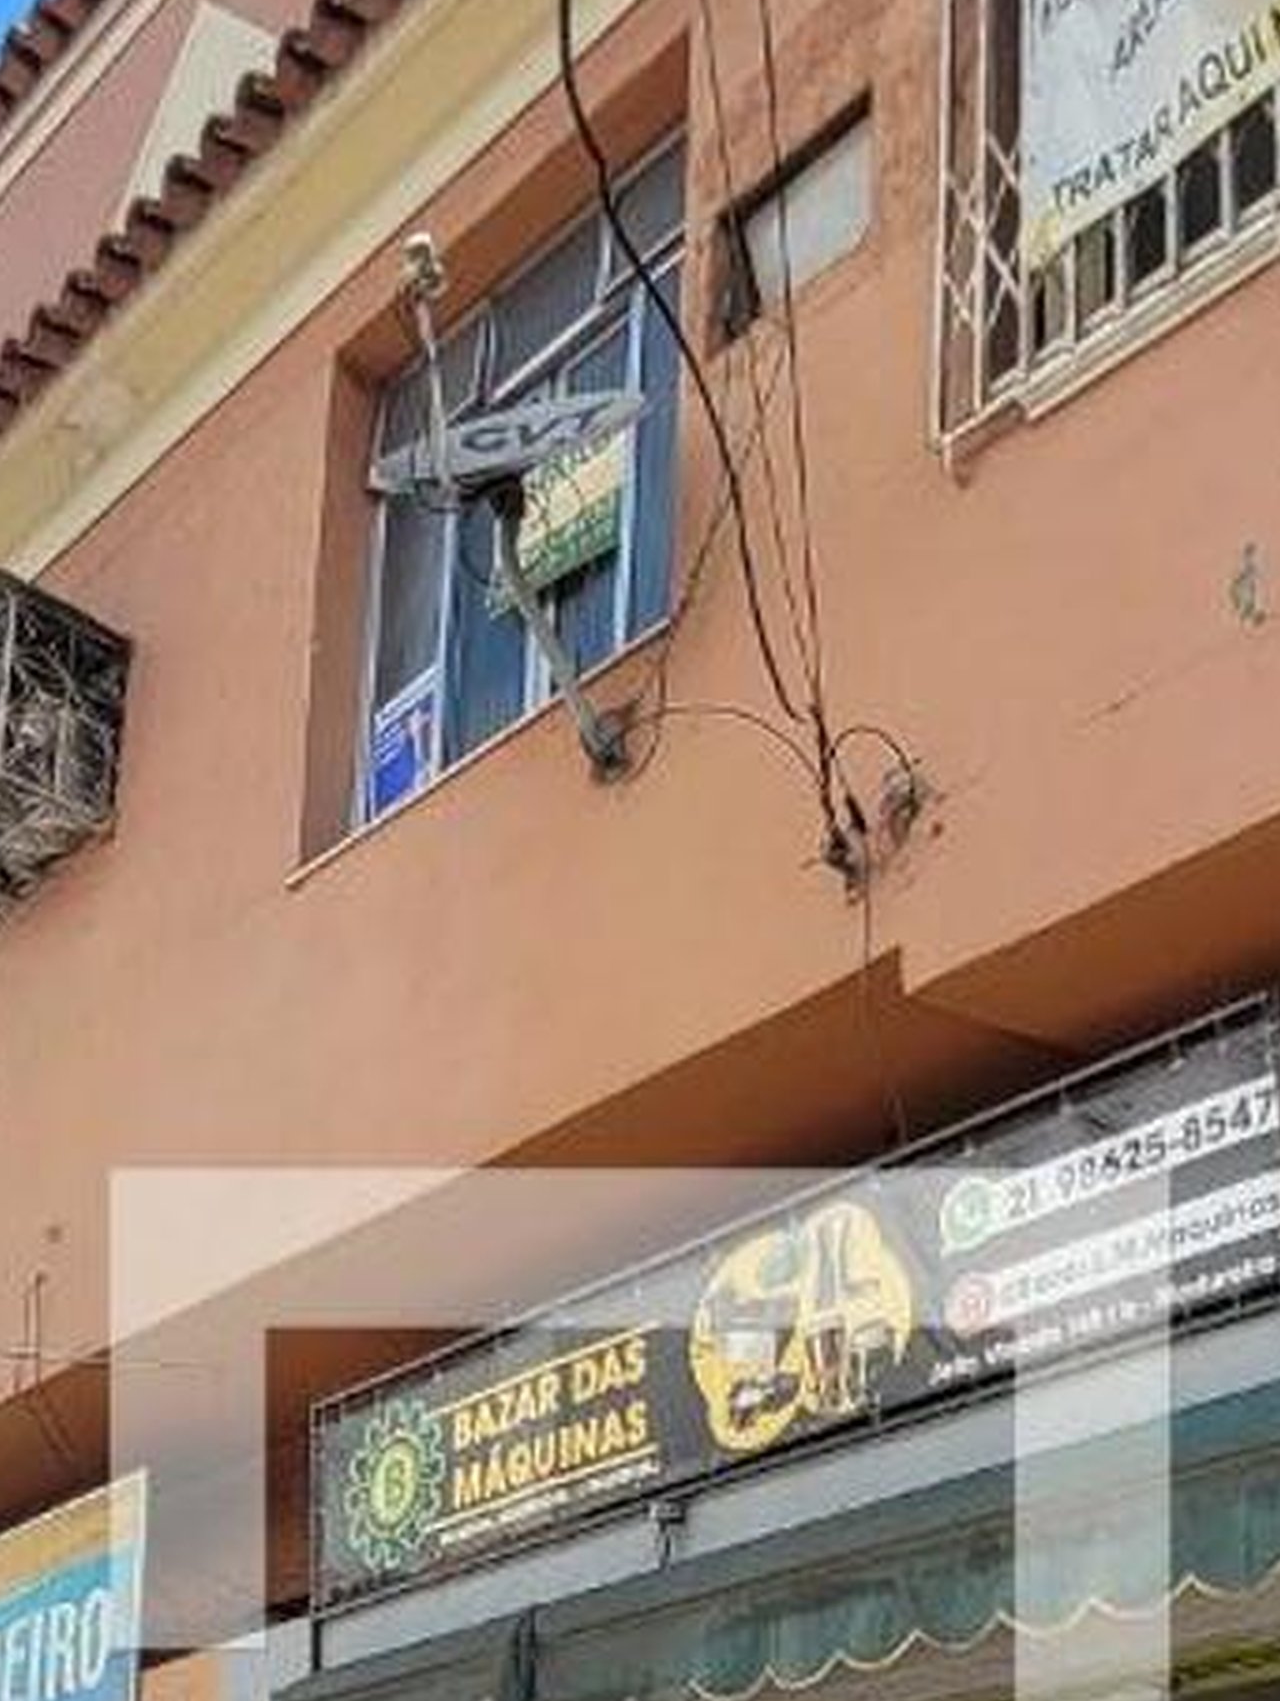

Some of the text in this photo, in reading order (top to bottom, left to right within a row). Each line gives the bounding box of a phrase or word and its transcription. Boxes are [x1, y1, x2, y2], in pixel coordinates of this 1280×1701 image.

[1051, 110, 1174, 212] TRATAR
[1178, 27, 1268, 123] AQUI
[453, 1336, 648, 1451] BAZAR DAS
[452, 1401, 648, 1509] MÁQUINAS
